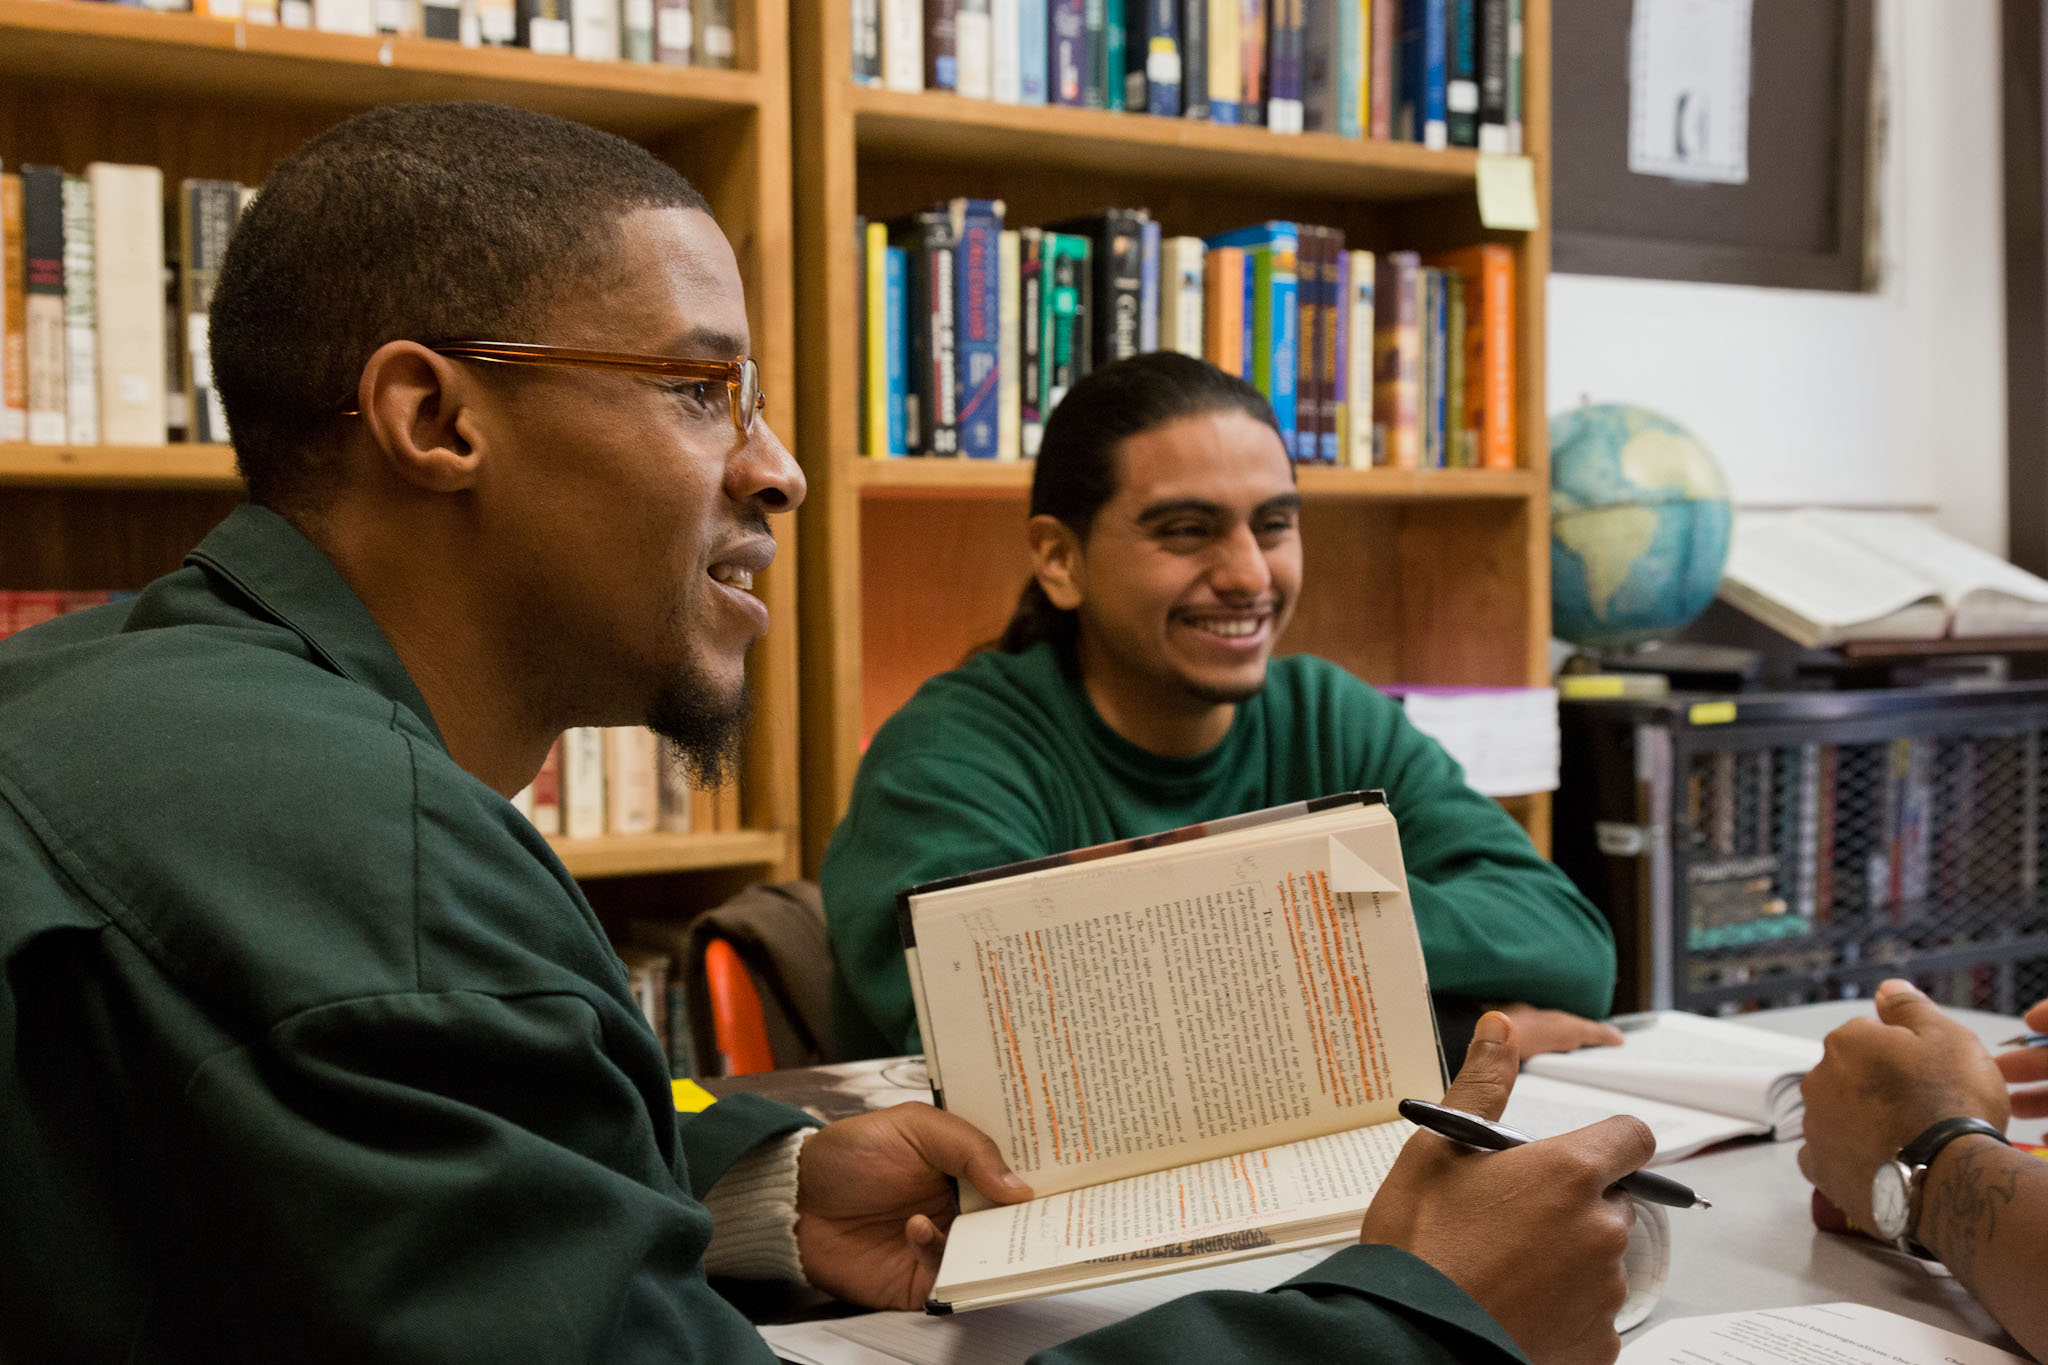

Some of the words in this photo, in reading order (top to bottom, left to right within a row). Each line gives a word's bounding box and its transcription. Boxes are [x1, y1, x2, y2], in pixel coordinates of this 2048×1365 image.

[1213, 892, 1224, 905] ing
[1225, 890, 1235, 904] and
[1236, 888, 1245, 896] of
[1244, 885, 1258, 910] during
[1144, 906, 1153, 919] the
[1154, 904, 1165, 928] sexual
[1184, 899, 1193, 916] even
[1193, 896, 1208, 930] sumption
[1205, 894, 1217, 920] models
[1251, 911, 1258, 920] an
[1123, 910, 1134, 931] black
[1135, 918, 1145, 933] The
[1162, 902, 1178, 936] projected
[1172, 900, 1188, 935] perennial
[1188, 917, 1198, 930] the
[1211, 922, 1219, 930] of
[1218, 906, 1233, 944] Americans
[1229, 905, 1244, 945] convenient
[1237, 903, 1252, 933] thriving
[1139, 936, 1149, 953] civil
[1169, 937, 1180, 947] by
[1189, 932, 1204, 964] intensely
[1202, 932, 1211, 946] and
[1212, 932, 1222, 945] the
[1245, 933, 1254, 952] mass
[1252, 921, 1272, 976] unprecedented
[1007, 949, 1018, 971] direct
[1127, 932, 1142, 971] Americans
[1181, 937, 1195, 972] economic
[1213, 946, 1226, 965] good
[1226, 946, 1235, 957] for
[1237, 946, 1249, 977] services
[1270, 949, 1281, 970] black
[1140, 956, 1154, 978] rights
[1219, 966, 1229, 979] life
[1228, 957, 1238, 970] the
[1011, 972, 1023, 995] selfish
[1135, 971, 1144, 980] to
[1166, 969, 1174, 983] was
[1176, 965, 1184, 983] mass
[1196, 966, 1211, 997] political
[1231, 971, 1241, 986] first
[1136, 980, 1149, 1005] benefit
[1169, 985, 1178, 1006] never
[1189, 975, 1200, 996] boom
[1243, 978, 1257, 1011] available
[1255, 982, 1265, 998] The
[1265, 976, 1279, 1012] American
[1275, 973, 1287, 999] middle
[1147, 981, 1161, 1017] movement
[1193, 998, 1203, 1013] and
[1220, 981, 1237, 1021] principally
[1141, 1006, 1152, 1024] from
[1174, 1007, 1182, 1015] at
[1202, 998, 1218, 1031] struggles
[1250, 1013, 1259, 1021] to
[1258, 998, 1272, 1033] economic
[1281, 1001, 1292, 1020] class
[1145, 1025, 1154, 1037] the
[1175, 1017, 1185, 1029] the
[1195, 1016, 1209, 1044] posited
[1230, 1023, 1239, 1031] in
[1238, 1008, 1253, 1044] American
[1250, 1022, 1263, 1042] large
[1272, 1012, 1286, 1047] economic
[1285, 1023, 1294, 1042] came
[1153, 1021, 1169, 1057] permitted
[1178, 1030, 1190, 1054] center
[1211, 1032, 1219, 1040] of
[1233, 1034, 1244, 1054] terms
[1266, 1035, 1277, 1055] boom
[1147, 1038, 1162, 1074] American
[1213, 1041, 1222, 1054] the
[1246, 1045, 1254, 1064] mass
[1290, 1044, 1298, 1053] of
[1183, 1055, 1192, 1064] of
[1193, 1052, 1206, 1084] financial
[1203, 1046, 1215, 1073] models
[1216, 1056, 1227, 1080] sixties
[1224, 1051, 1240, 1086] important
[1237, 1056, 1246, 1065] of
[1256, 1042, 1270, 1075] numbers
[1270, 1056, 1282, 1077] made
[1280, 1048, 1291, 1069] boom
[1290, 1055, 1299, 1069] age
[1160, 1060, 1177, 1098] significant
[1209, 1075, 1218, 1084] of
[1250, 1064, 1262, 1091] culture
[1263, 1075, 1272, 1084] of
[1284, 1068, 1294, 1083] and
[1295, 1071, 1304, 1079] in
[1154, 1074, 1168, 1109] economic
[1184, 1072, 1199, 1103] political
[1211, 1086, 1221, 1099] the
[1233, 1088, 1242, 1096] to
[1238, 1066, 1255, 1111] conspicuous
[1273, 1077, 1287, 1101] luxury
[1287, 1084, 1295, 1092] in
[1298, 1081, 1307, 1094] the
[1219, 1081, 1237, 1126] presupposed
[1235, 1098, 1246, 1114] note
[1289, 1092, 1299, 1104] the
[1171, 1101, 1184, 1132] numbers
[1191, 1104, 1205, 1130] agenda
[1212, 1102, 1225, 1120] good
[1254, 1092, 1270, 1126] presented
[1278, 1101, 1291, 1121] goods
[1292, 1105, 1302, 1119] hub
[1208, 1122, 1218, 1136] and
[1219, 1122, 1228, 1135] life
[1239, 1116, 1249, 1130] that
[1178, 1135, 1186, 1144] of
[1198, 1130, 1206, 1139] in
